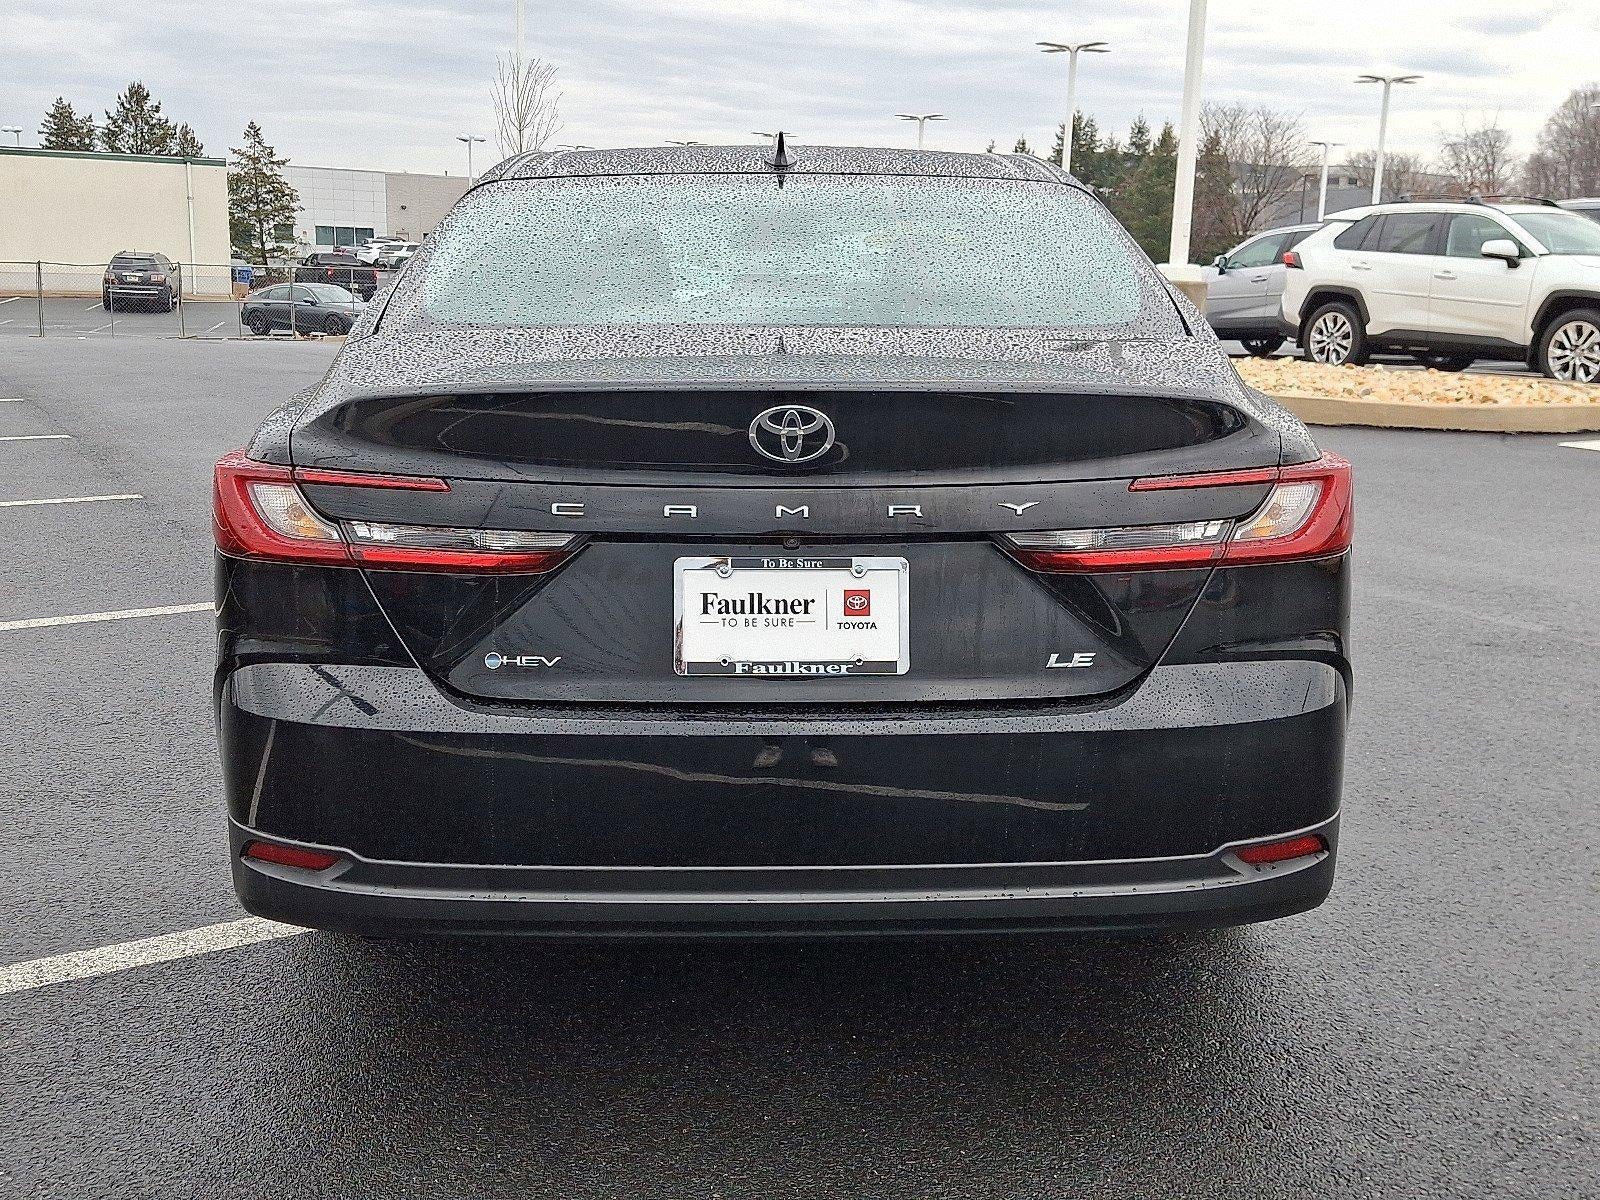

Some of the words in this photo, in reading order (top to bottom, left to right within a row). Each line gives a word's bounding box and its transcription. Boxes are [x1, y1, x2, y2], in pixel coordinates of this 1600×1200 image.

[551, 501, 1040, 518] CAMRY
[761, 558, 775, 568] To
[779, 558, 794, 568] Be
[796, 558, 823, 569] Sure
[700, 592, 816, 616] Faulkner
[721, 618, 738, 627] TO
[744, 618, 758, 627] BE
[764, 618, 795, 627] SURE
[837, 622, 877, 630] TOYOTA
[1045, 652, 1097, 668] LE
[734, 661, 853, 674] Faulkner
